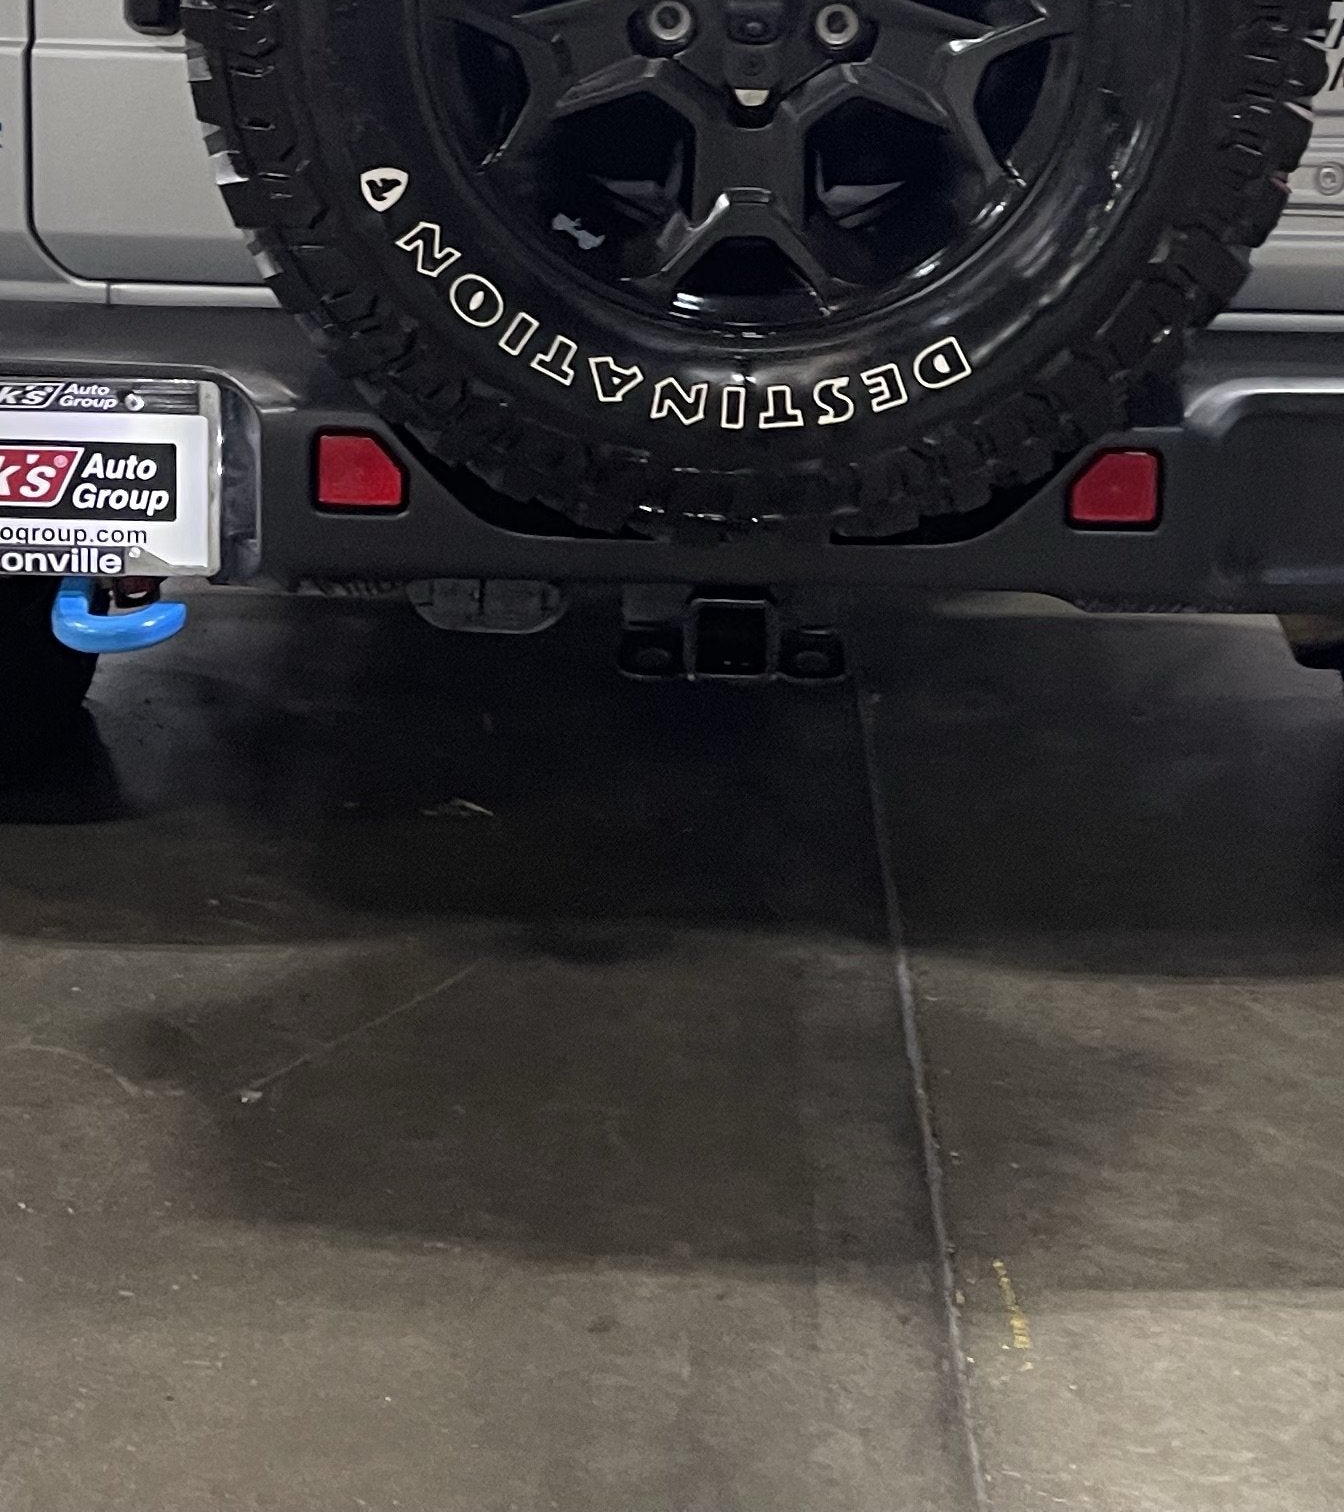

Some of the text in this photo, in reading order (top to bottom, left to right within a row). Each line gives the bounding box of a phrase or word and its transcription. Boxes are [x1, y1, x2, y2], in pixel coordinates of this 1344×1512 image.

[397, 222, 972, 429] DESTINATION
[59, 395, 119, 410] Group
[64, 383, 110, 396] Auto
[81, 453, 157, 482] Auto
[71, 482, 169, 515] Group
